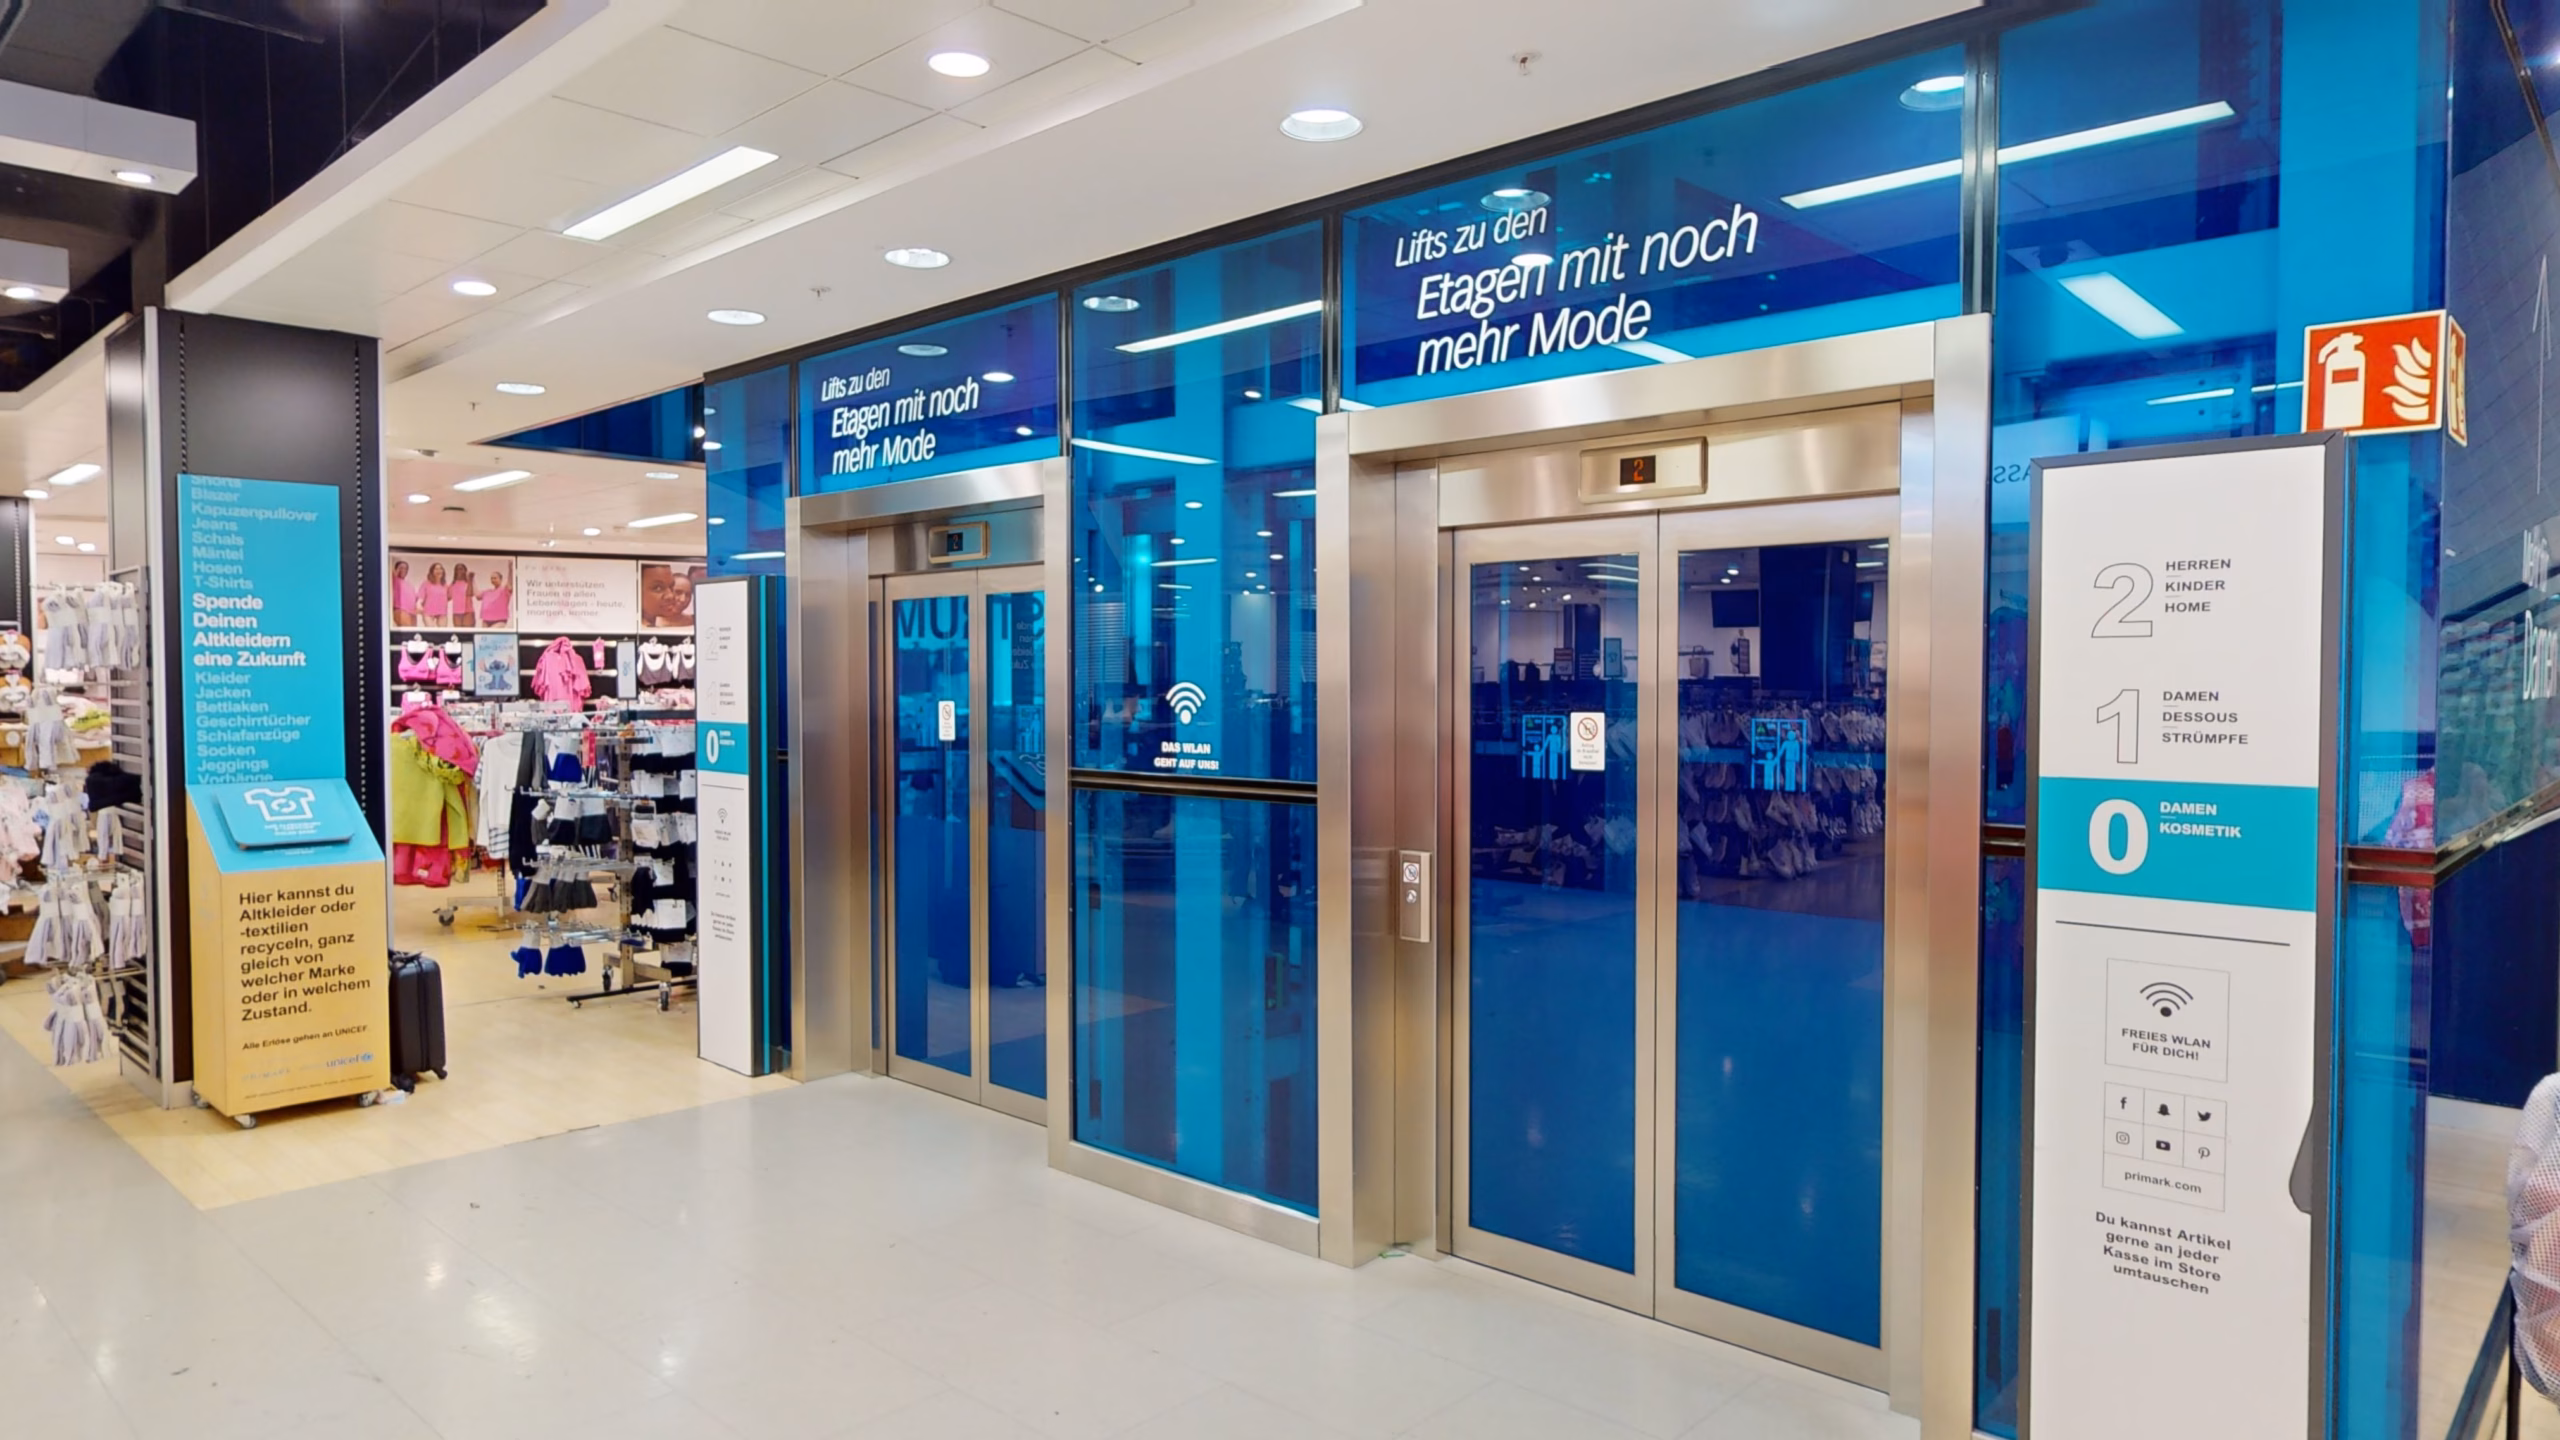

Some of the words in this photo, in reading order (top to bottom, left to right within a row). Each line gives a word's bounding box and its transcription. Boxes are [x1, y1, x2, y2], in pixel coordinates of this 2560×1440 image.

[1395, 230, 1447, 268] Lifts
[1453, 221, 1486, 254] zu
[1493, 207, 1548, 245] den
[1416, 262, 1546, 320] Etagen
[1557, 231, 1630, 292] mit
[1639, 203, 1759, 275] noch
[1416, 316, 1521, 376] mehr
[1528, 292, 1652, 357] Mode
[821, 376, 847, 402] Lifts
[848, 376, 865, 394] zu
[866, 366, 891, 391] den
[831, 399, 890, 439] Etagen
[893, 388, 926, 425] mit
[928, 376, 980, 418] noch
[832, 440, 879, 475] mehr
[882, 428, 936, 466] Mode
[1633, 458, 1645, 483] 2
[191, 488, 240, 502] Blazer
[191, 503, 317, 523] Kapuzenpullover
[192, 518, 238, 531] Jeans
[192, 532, 244, 546] Schals
[193, 546, 244, 560] Mäntel
[193, 561, 242, 575] Hosen
[2165, 558, 2231, 572] HERREN
[194, 576, 253, 589] T-Shirts
[2165, 579, 2226, 592] KINDER
[193, 593, 263, 612] Spende
[2091, 562, 2154, 639] 2
[2165, 601, 2211, 613] HOME
[194, 612, 257, 629] Deinen
[193, 631, 291, 648] Altkleidern
[194, 653, 232, 666] eine
[237, 651, 306, 667] Zukunft
[195, 672, 251, 684] Kleider
[195, 686, 251, 699] Jacken
[2163, 690, 2220, 702] DAMEN
[196, 701, 269, 713] Bettlaken
[196, 713, 310, 727] Geschirrtücher
[2096, 688, 2140, 764] 1
[2162, 711, 2238, 724] DESSOUS
[197, 728, 301, 742] Schlafanzüge
[2161, 730, 2249, 745] STRÜMPFE
[197, 743, 255, 756] Socken
[705, 728, 720, 764] 0
[1161, 741, 1181, 753] DAS
[1182, 742, 1211, 755] WLAN
[198, 758, 268, 772] Jeggings
[1153, 757, 1177, 767] GEHT
[1178, 758, 1196, 769] AUF
[1197, 759, 1219, 770] UNS!
[2160, 801, 2218, 816] DAMEN
[2088, 798, 2150, 876] 0
[2159, 821, 2242, 839] KOSMETIK
[239, 891, 273, 906] Hier
[277, 886, 331, 902] kannst
[335, 884, 355, 897] du
[239, 904, 316, 922] Altkleider
[321, 899, 356, 914] oder
[240, 922, 309, 938] -textilien
[241, 936, 313, 955] recyceln,
[318, 932, 355, 949] ganz
[241, 956, 290, 974] gleich
[295, 952, 324, 966] von
[241, 969, 305, 988] welcher
[309, 964, 356, 980] Marke
[241, 989, 279, 1005] oder
[284, 988, 298, 999] in
[302, 979, 371, 997] welchem
[241, 1003, 313, 1022] Zustand.
[242, 1041, 260, 1051] Alle
[262, 1037, 291, 1047] Erlöse
[293, 1033, 320, 1044] gehen
[322, 1030, 333, 1038] an
[2121, 1027, 2168, 1044] FREIES
[2171, 1034, 2212, 1050] WLAN
[2132, 1041, 2159, 1056] FÜR
[2162, 1046, 2200, 1062] DICH!
[2124, 1170, 2202, 1194] primark.com
[2095, 1211, 2116, 1227] Du
[2120, 1216, 2173, 1238] kannst
[2177, 1229, 2231, 1252] Artikel
[2105, 1230, 2150, 1251] gerne
[2154, 1241, 2173, 1255] an
[2178, 1243, 2219, 1266] jeder
[2103, 1245, 2149, 1266] Kasse
[2154, 1254, 2174, 1271] im
[2179, 1261, 2221, 1282] Store
[2113, 1263, 2210, 1295] umtauschen
